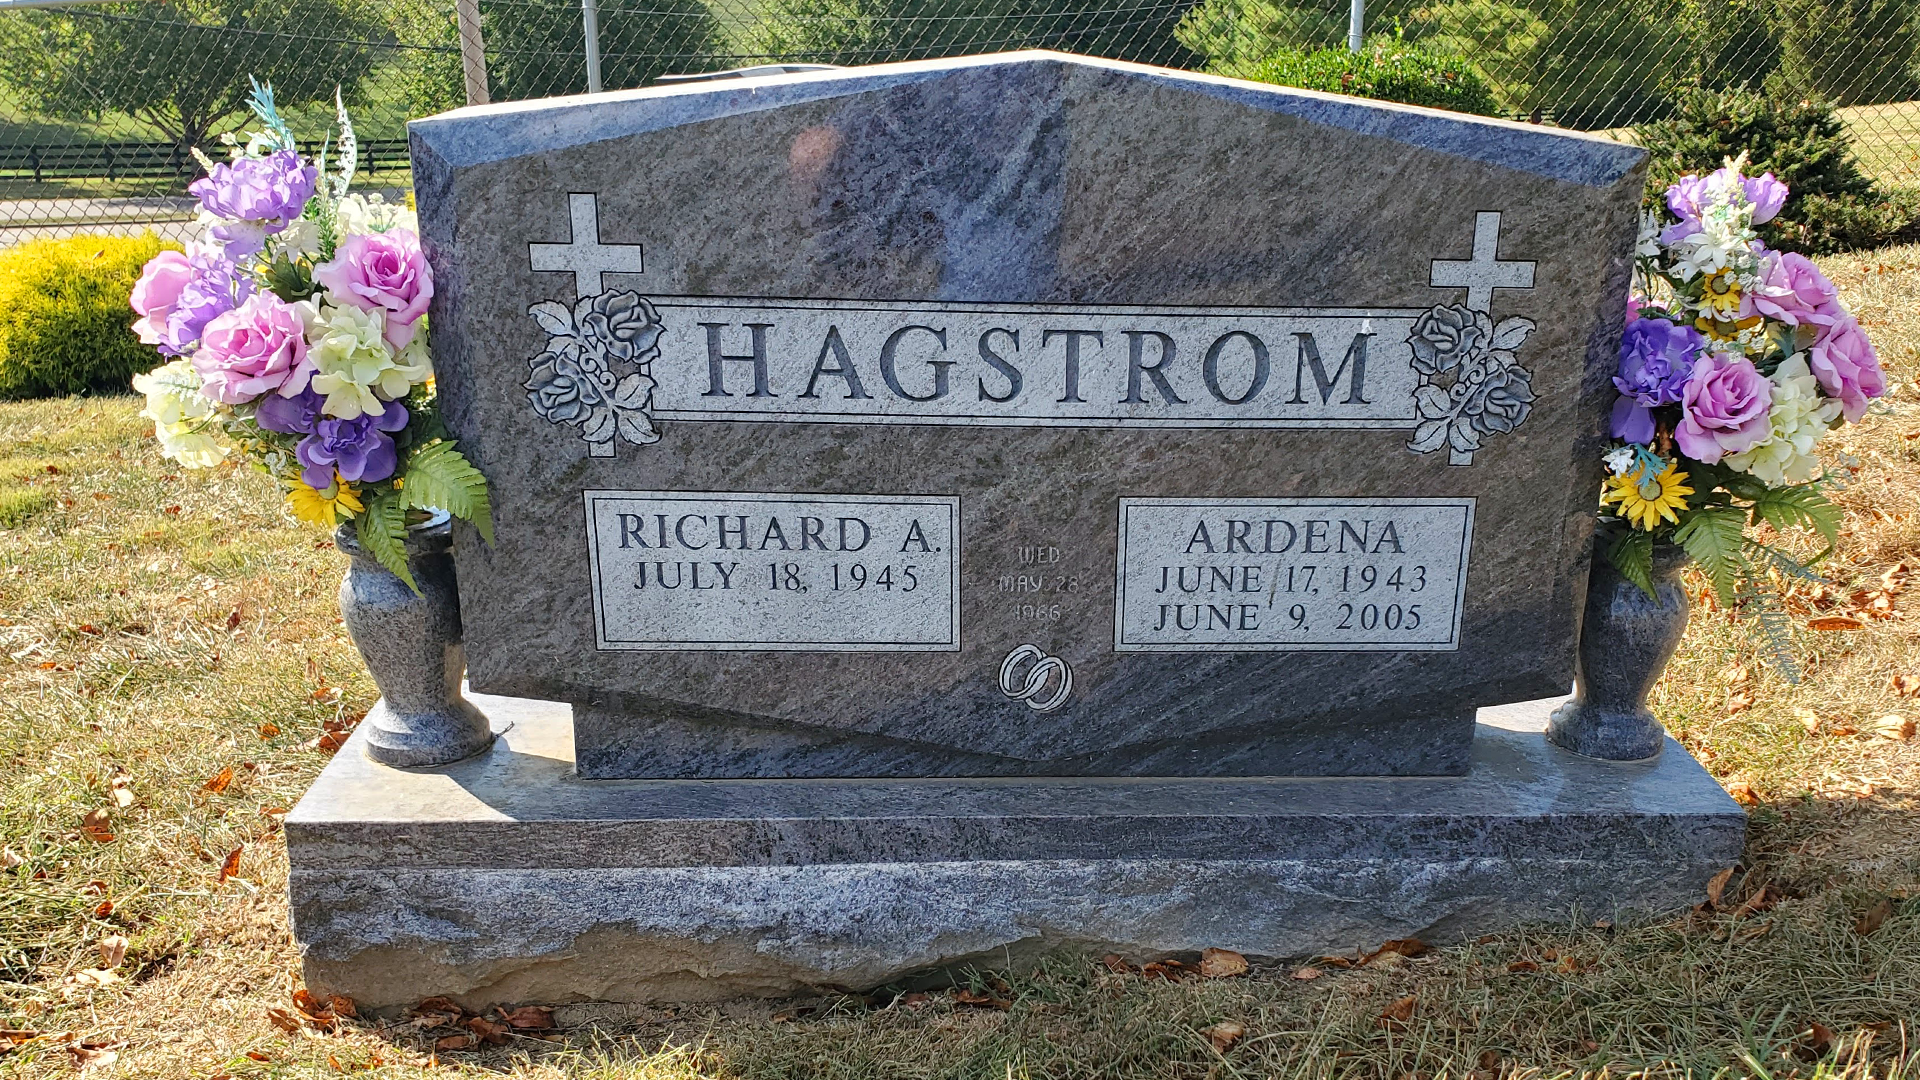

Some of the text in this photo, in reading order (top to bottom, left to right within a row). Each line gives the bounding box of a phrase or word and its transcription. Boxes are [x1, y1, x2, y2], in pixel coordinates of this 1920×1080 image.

[696, 319, 1379, 408] HAGSTROM
[616, 512, 942, 553] RICHARD A.
[1182, 519, 1405, 554] ARDENA
[1018, 545, 1061, 565] WED
[633, 561, 918, 594] JULY 18, 1945
[999, 575, 1044, 593] MAY
[1154, 565, 1427, 596] JUNE 17, 1943
[1153, 603, 1422, 633] JUNE 9, 2005
